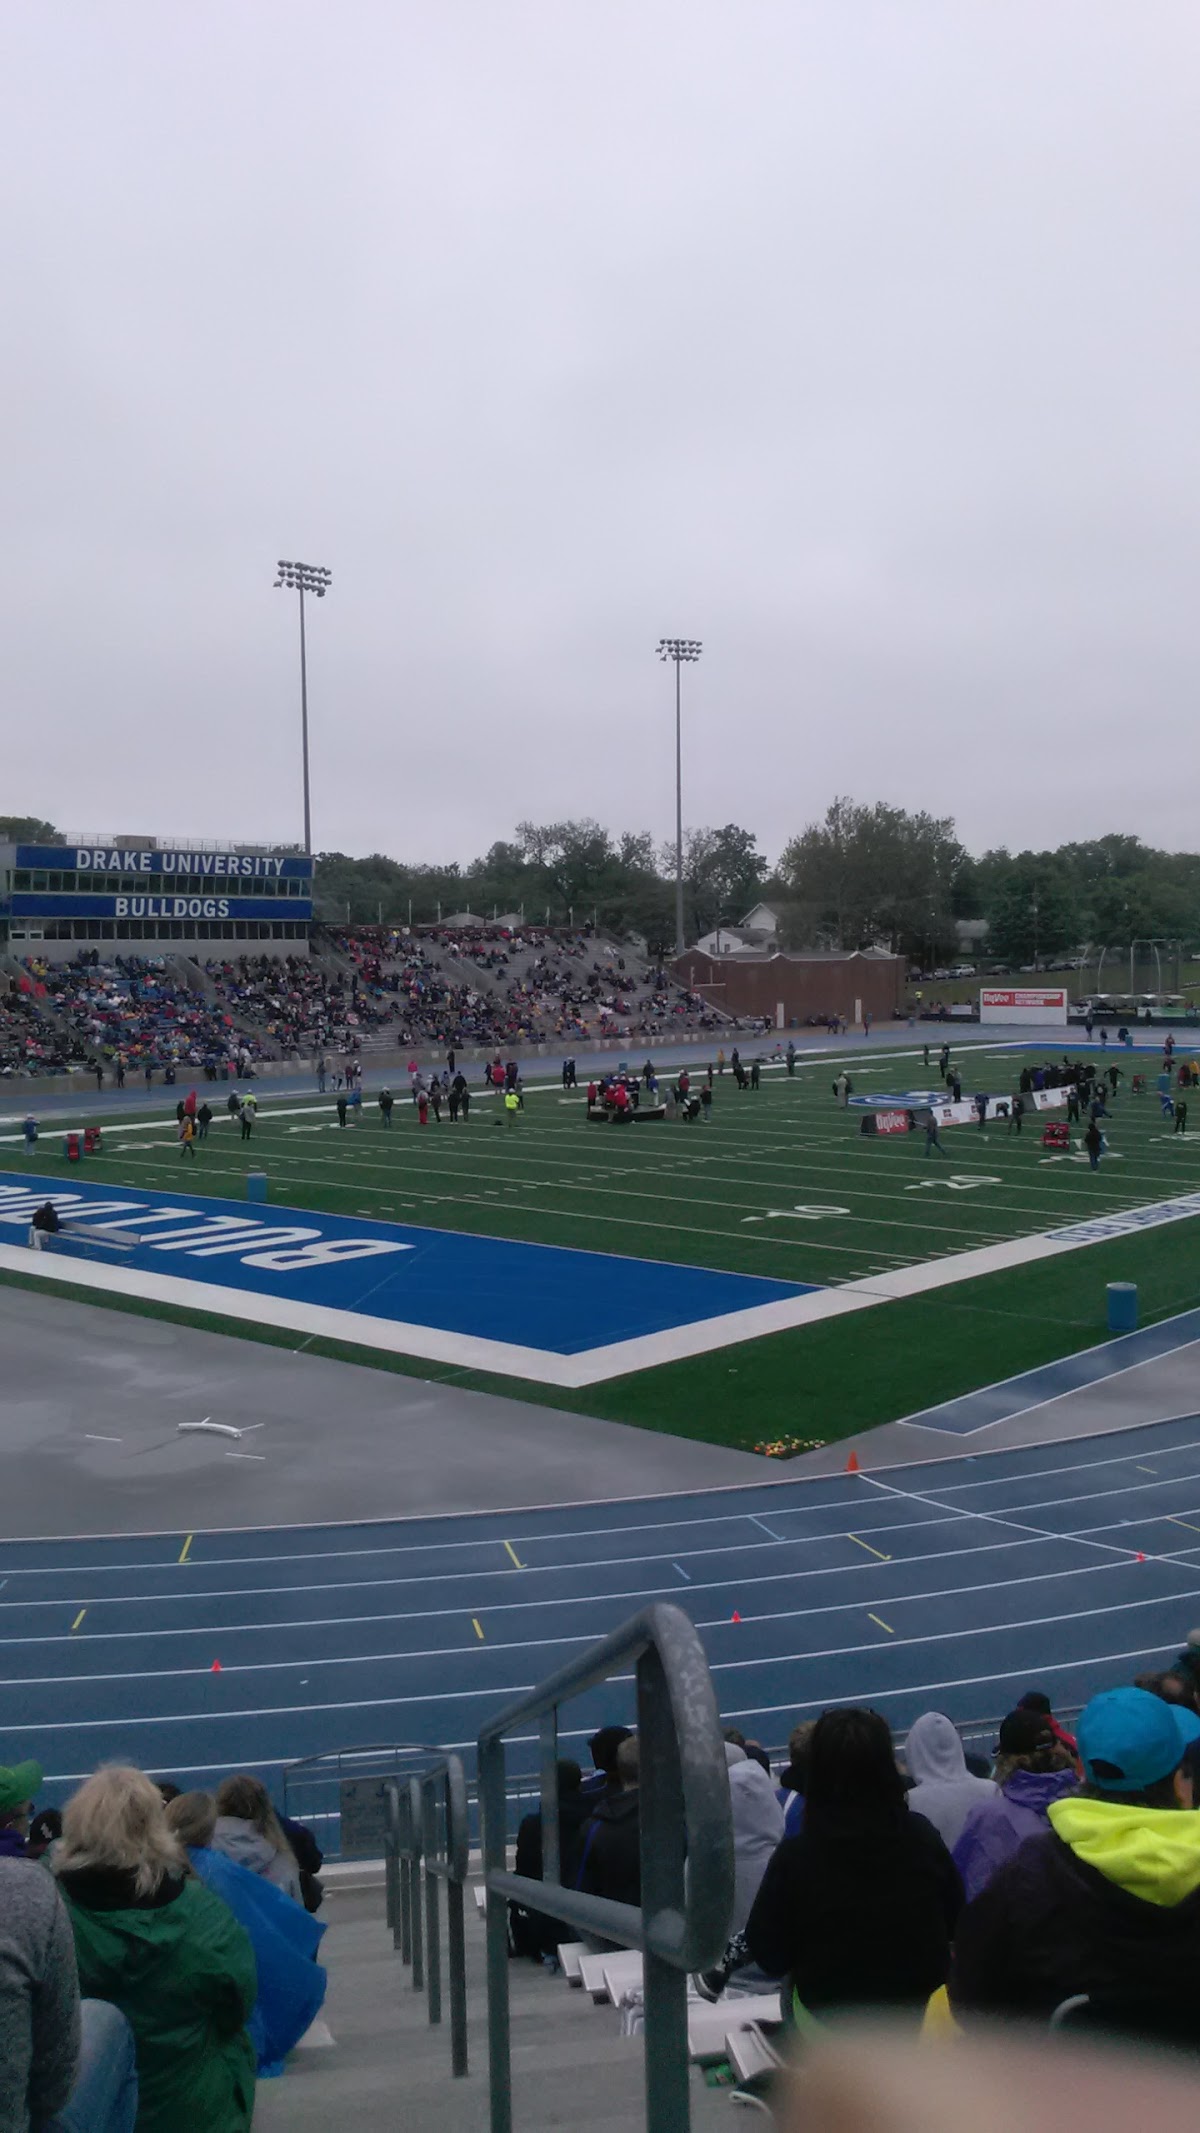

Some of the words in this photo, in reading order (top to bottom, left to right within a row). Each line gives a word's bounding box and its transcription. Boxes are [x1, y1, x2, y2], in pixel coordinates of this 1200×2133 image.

[76, 850, 152, 872] DRAKE
[162, 853, 285, 876] UNIVERSITY
[115, 897, 230, 917] BULLDOGS
[766, 1205, 850, 1220] 10
